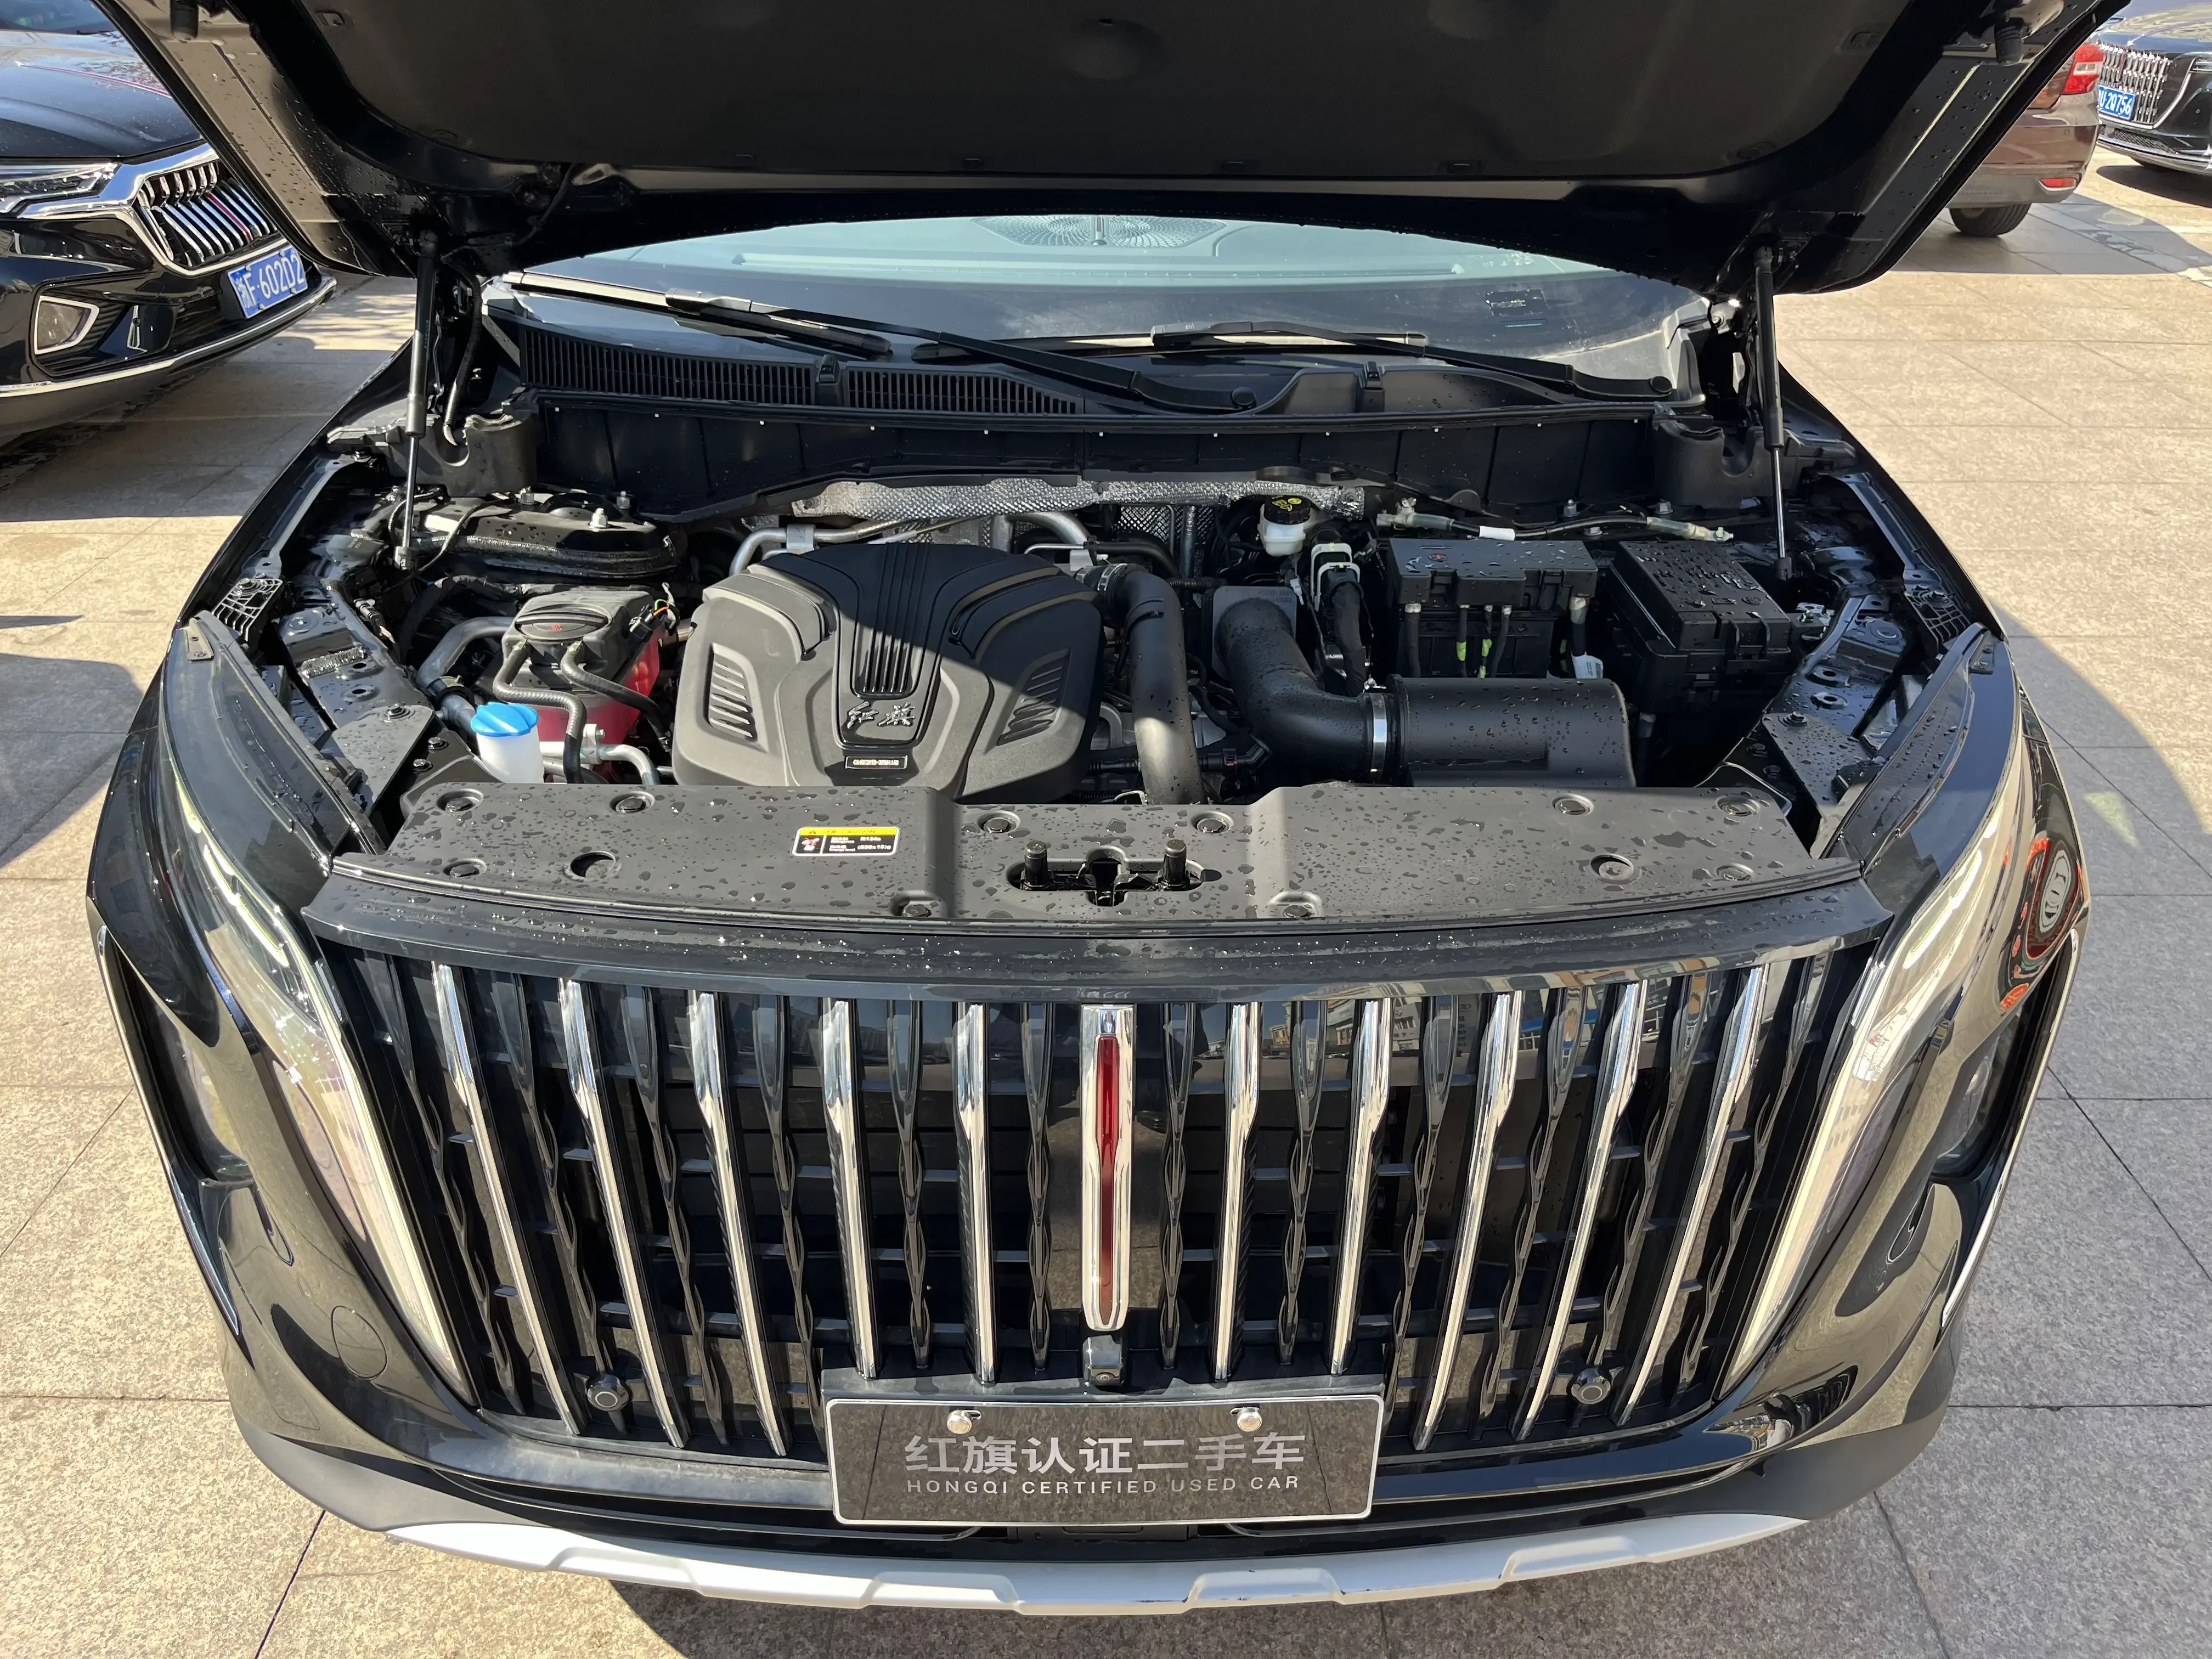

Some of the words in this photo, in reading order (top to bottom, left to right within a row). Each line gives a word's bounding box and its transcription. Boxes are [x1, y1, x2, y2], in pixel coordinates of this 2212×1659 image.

[847, 701, 916, 729] 红旗
[904, 1432, 1305, 1474] 红旗认证二手车
[907, 1480, 1008, 1495] HONGQI
[1023, 1480, 1156, 1494] CERTIFIED
[1171, 1478, 1237, 1492] USED
[1250, 1476, 1299, 1489] CAR
